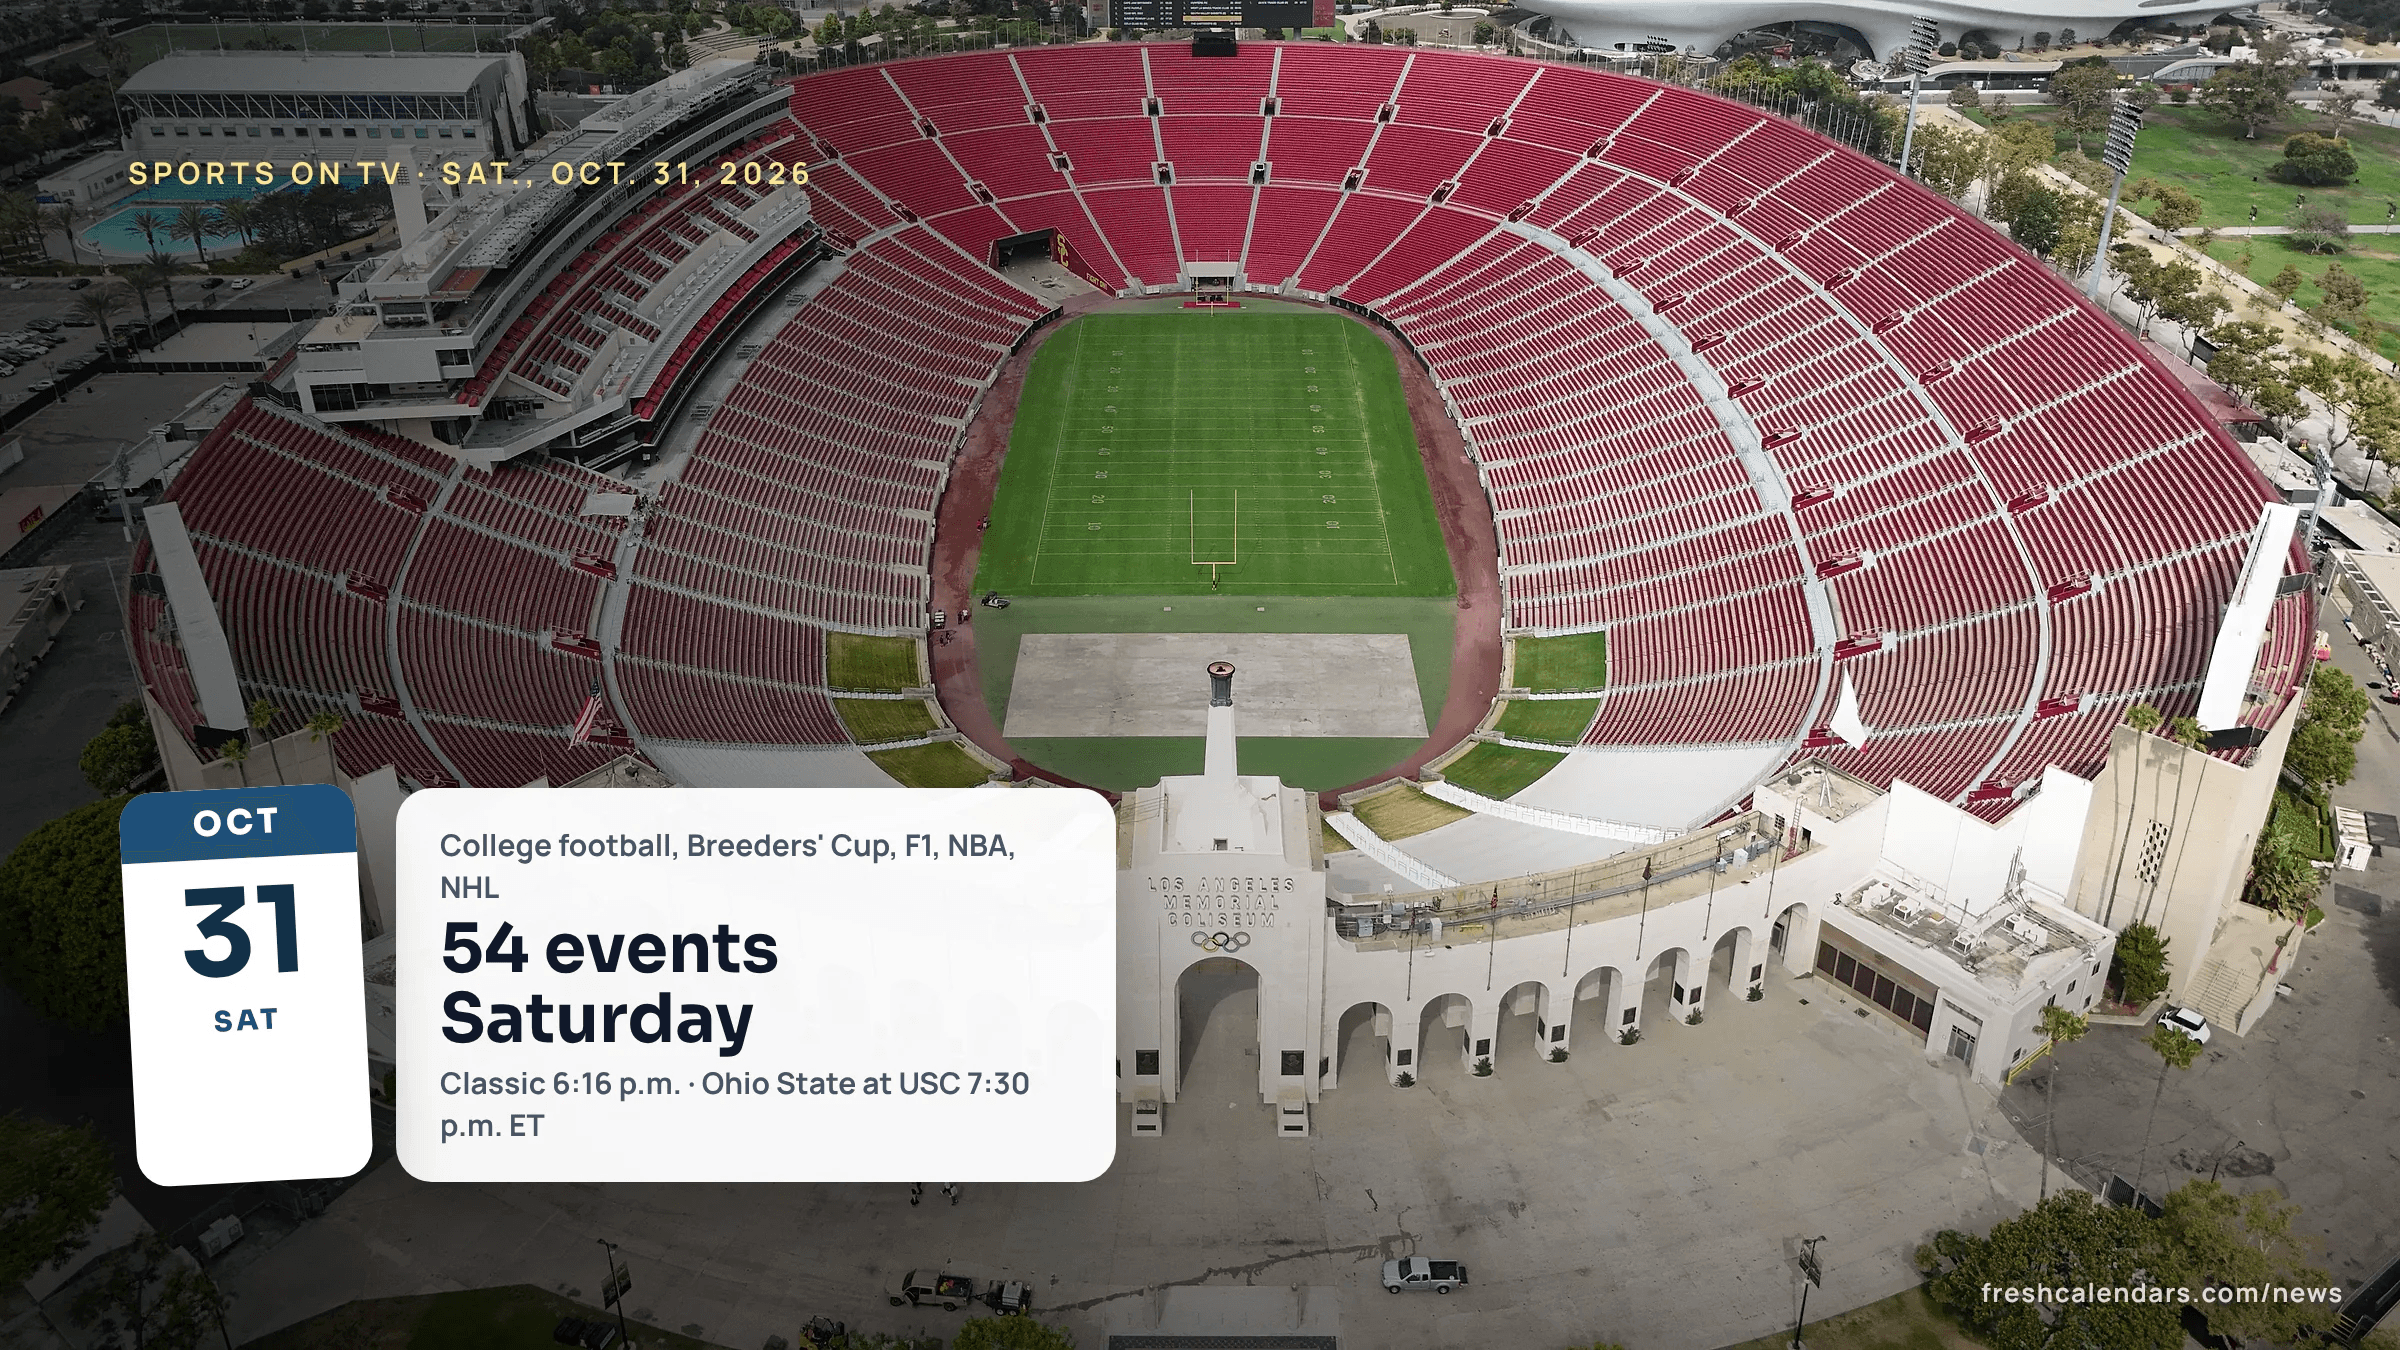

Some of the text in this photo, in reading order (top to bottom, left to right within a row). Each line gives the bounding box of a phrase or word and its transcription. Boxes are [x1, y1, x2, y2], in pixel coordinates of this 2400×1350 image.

[1147, 876, 1295, 893] LOS ANGELES
[1163, 894, 1280, 911] MEMORIAL
[1167, 912, 1276, 928] COLISEUM
